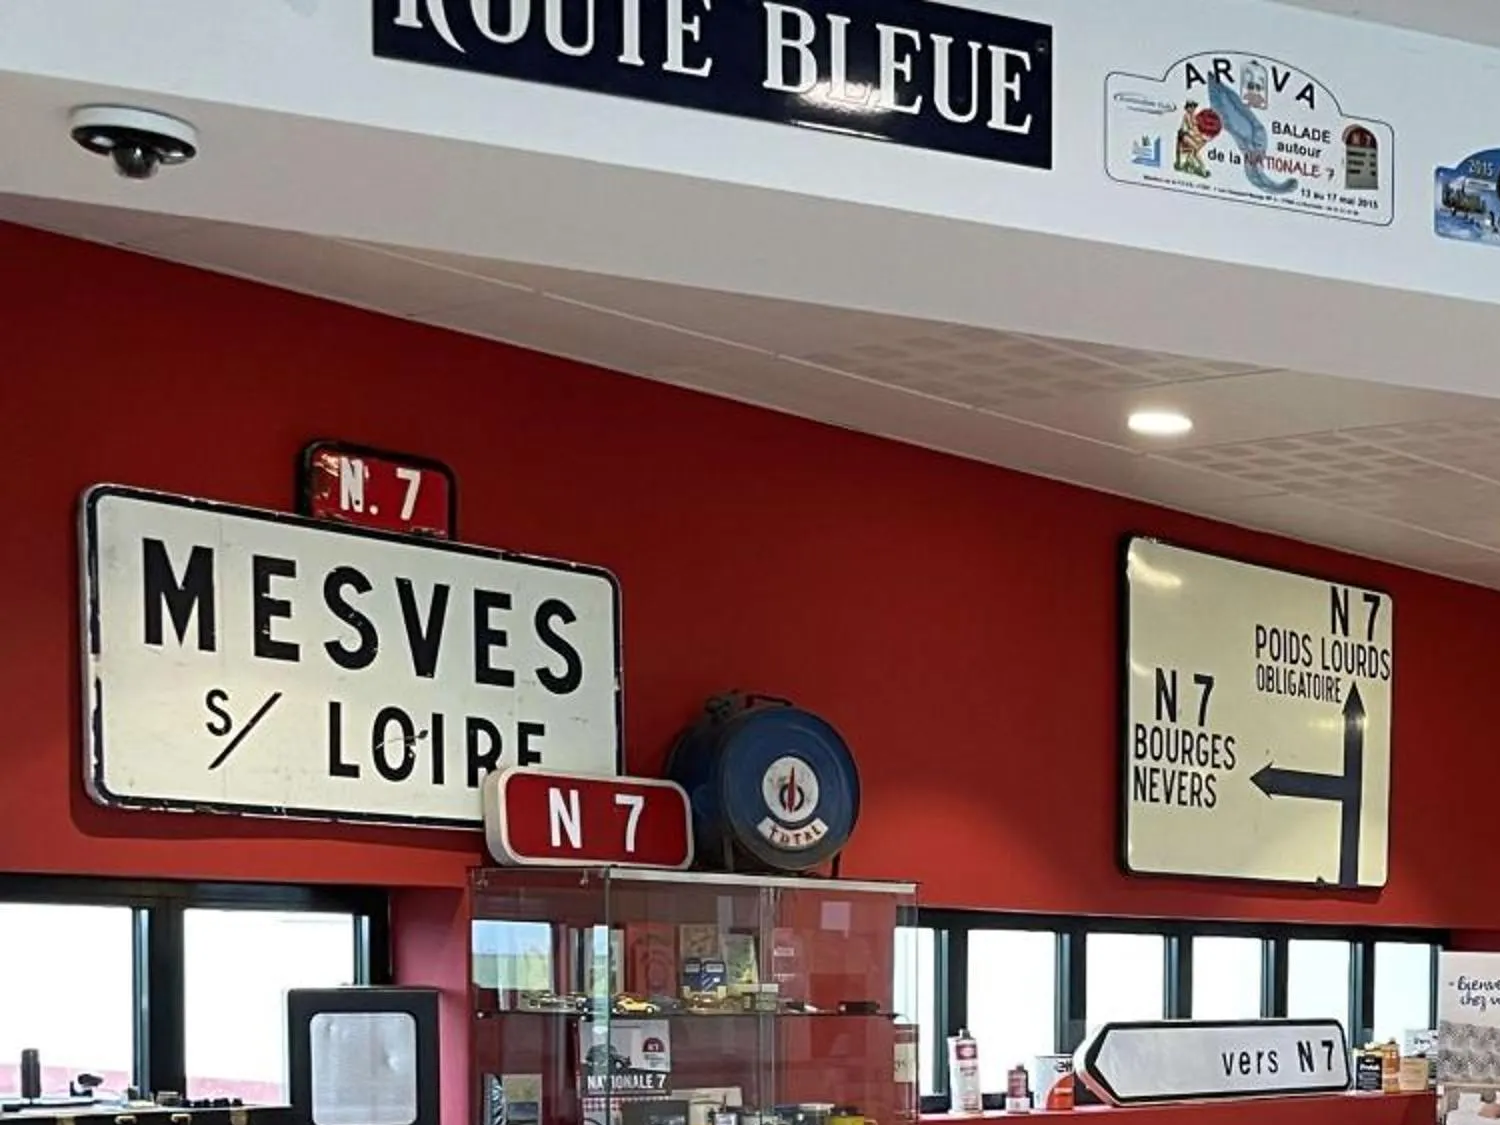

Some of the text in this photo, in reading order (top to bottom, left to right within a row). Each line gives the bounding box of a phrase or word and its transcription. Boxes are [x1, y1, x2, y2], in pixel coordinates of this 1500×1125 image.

[393, 0, 1033, 134] UTE BLEUE
[1271, 121, 1331, 144] BALADE
[1277, 140, 1321, 159] autour
[1207, 148, 1225, 163] de
[1229, 152, 1241, 165] la
[1243, 154, 1320, 179] NATIONALE
[396, 467, 421, 521] 7
[141, 537, 583, 695] MESVES
[1255, 624, 1390, 681] POIDS LOURDS
[1256, 665, 1342, 704] OBLIGATOIRE
[1134, 723, 1236, 771] BOURGES
[1133, 765, 1217, 809] NEVERS
[548, 787, 645, 853] N 7
[769, 825, 821, 845] TOTAL
[1222, 1050, 1278, 1076] vers
